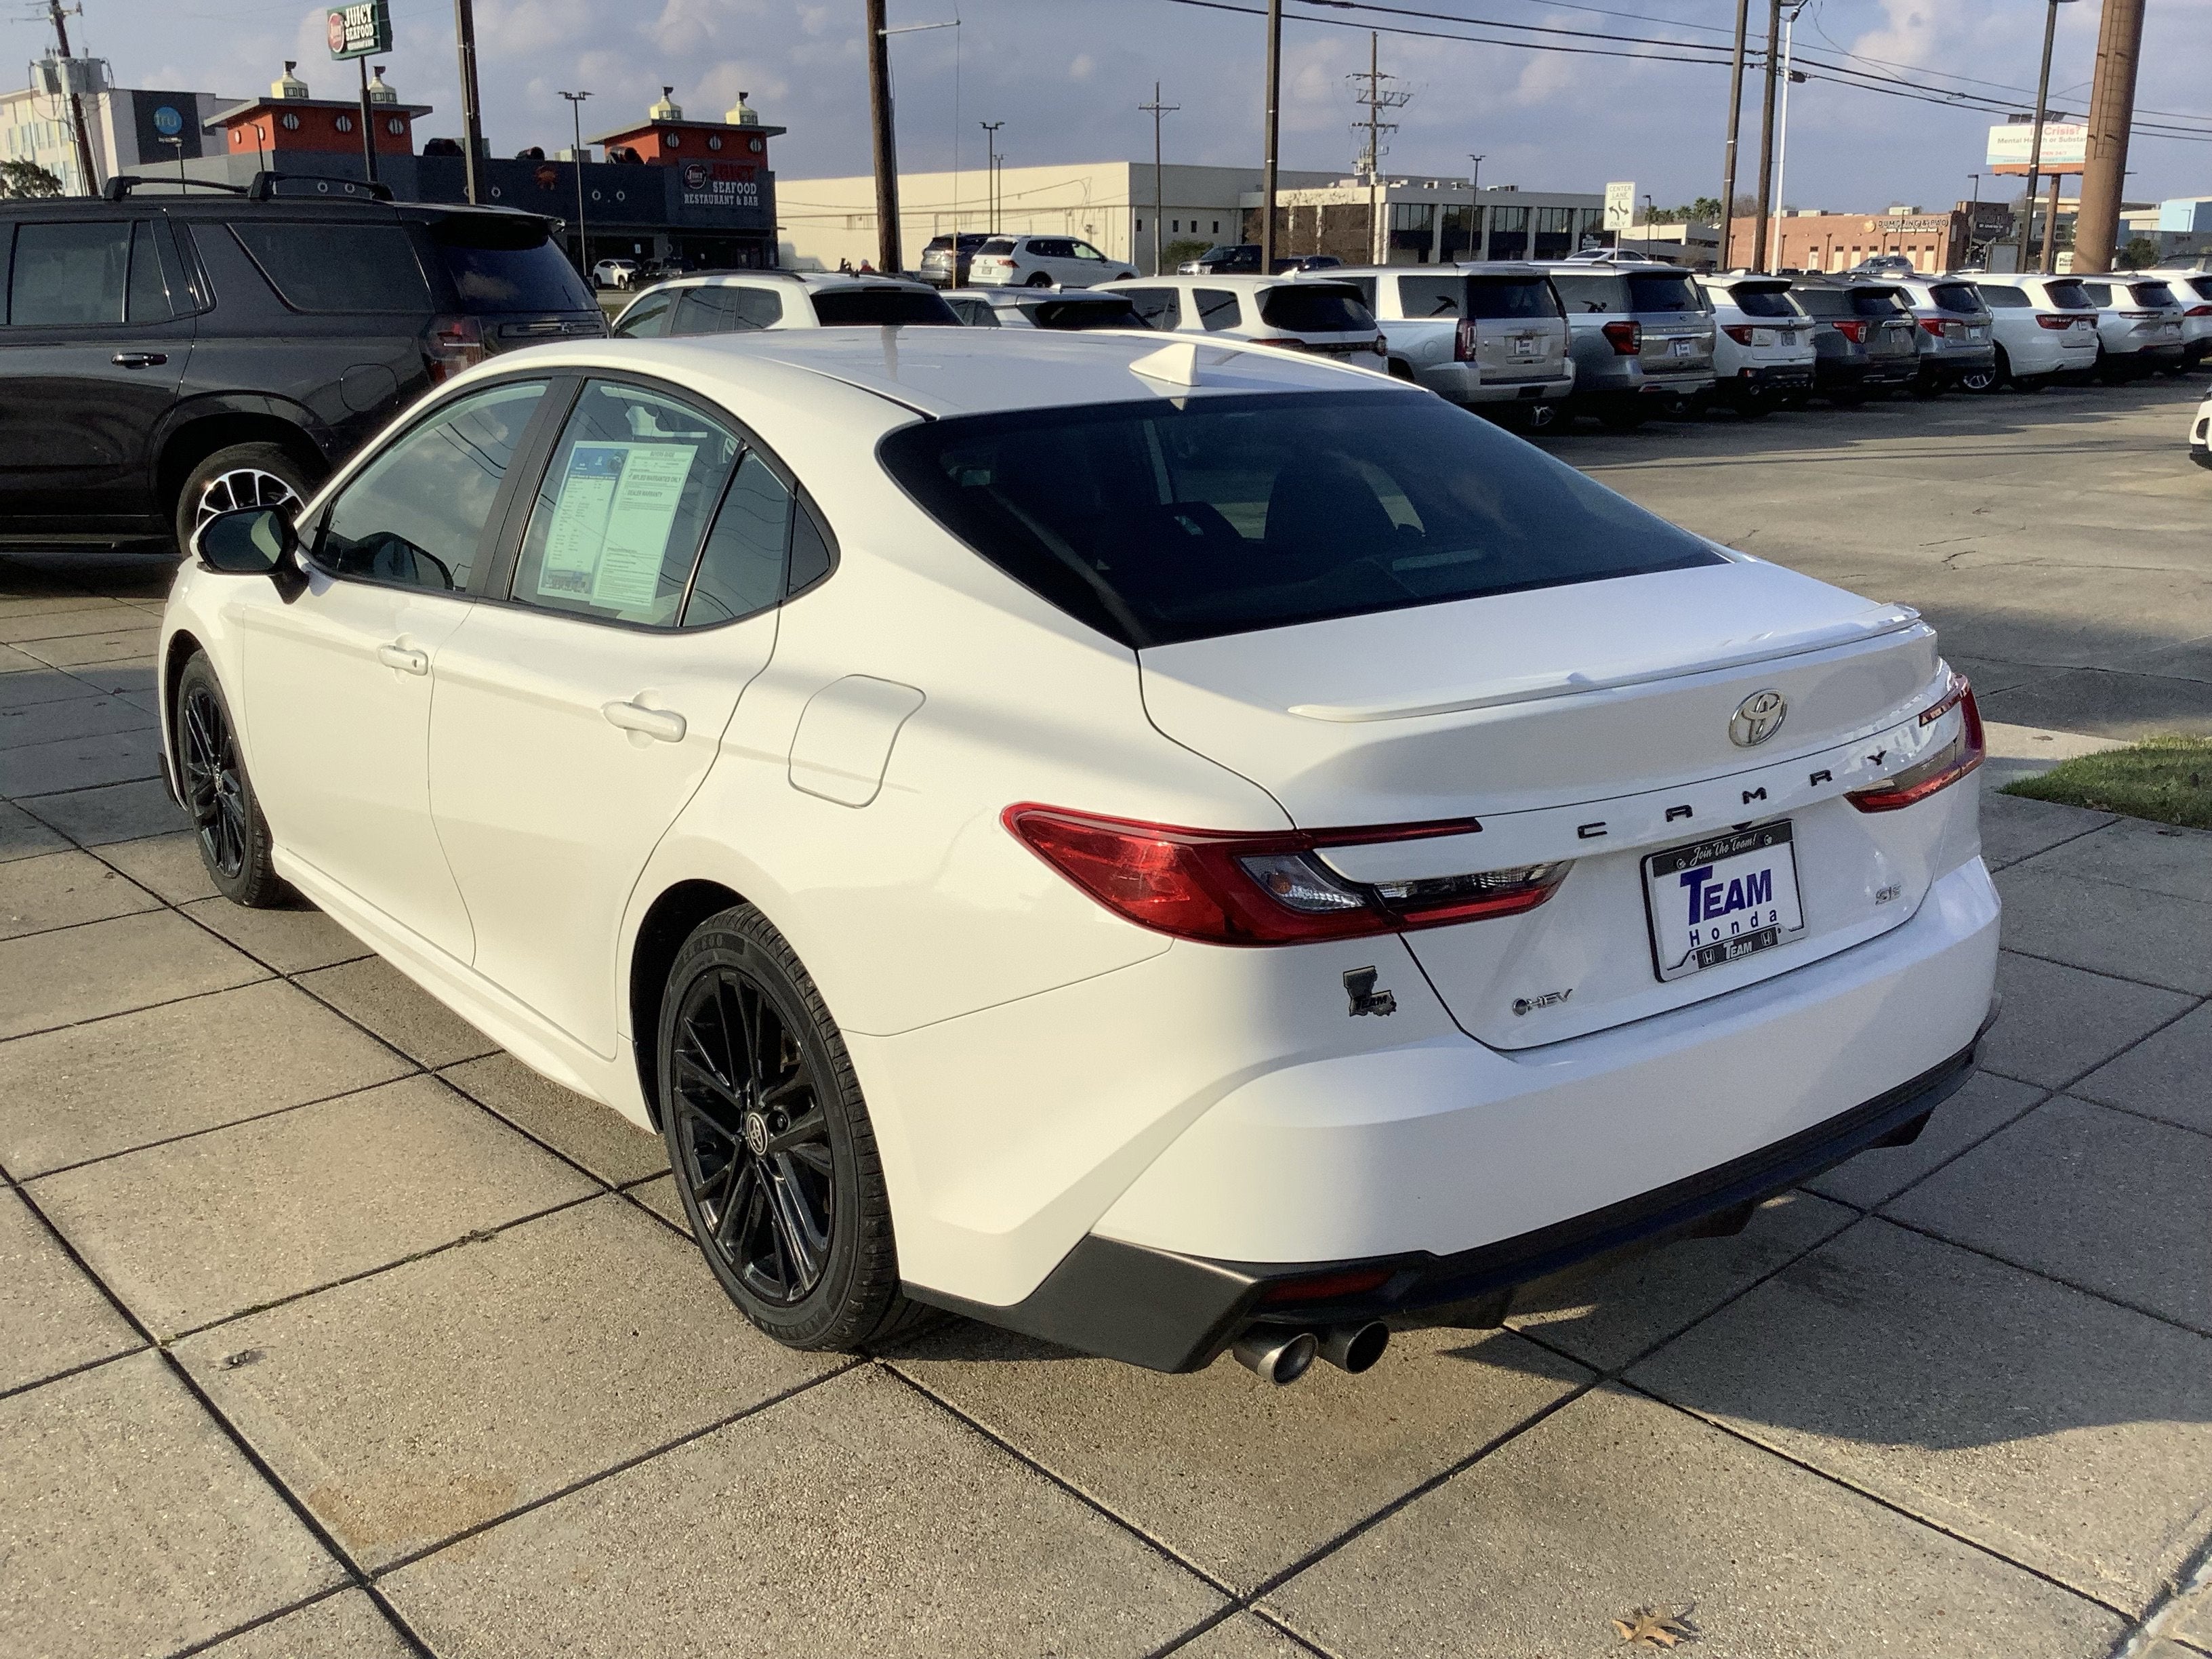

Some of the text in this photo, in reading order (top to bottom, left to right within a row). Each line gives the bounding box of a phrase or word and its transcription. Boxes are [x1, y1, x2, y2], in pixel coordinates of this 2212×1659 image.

[344, 3, 371, 27] JUICY
[346, 23, 374, 41] SEAFOOD
[2044, 125, 2081, 136] Crisis?
[713, 182, 757, 194] SEAFOOD
[684, 193, 758, 206] RESTAURANT & BAR
[1577, 750, 1887, 839] CAMRY
[1689, 833, 1757, 866] Join The Team!
[1680, 865, 1773, 926] TEAM
[1689, 909, 1777, 947] Honda
[1723, 941, 1753, 960] TEAM
[1527, 989, 1573, 1011] HEV
